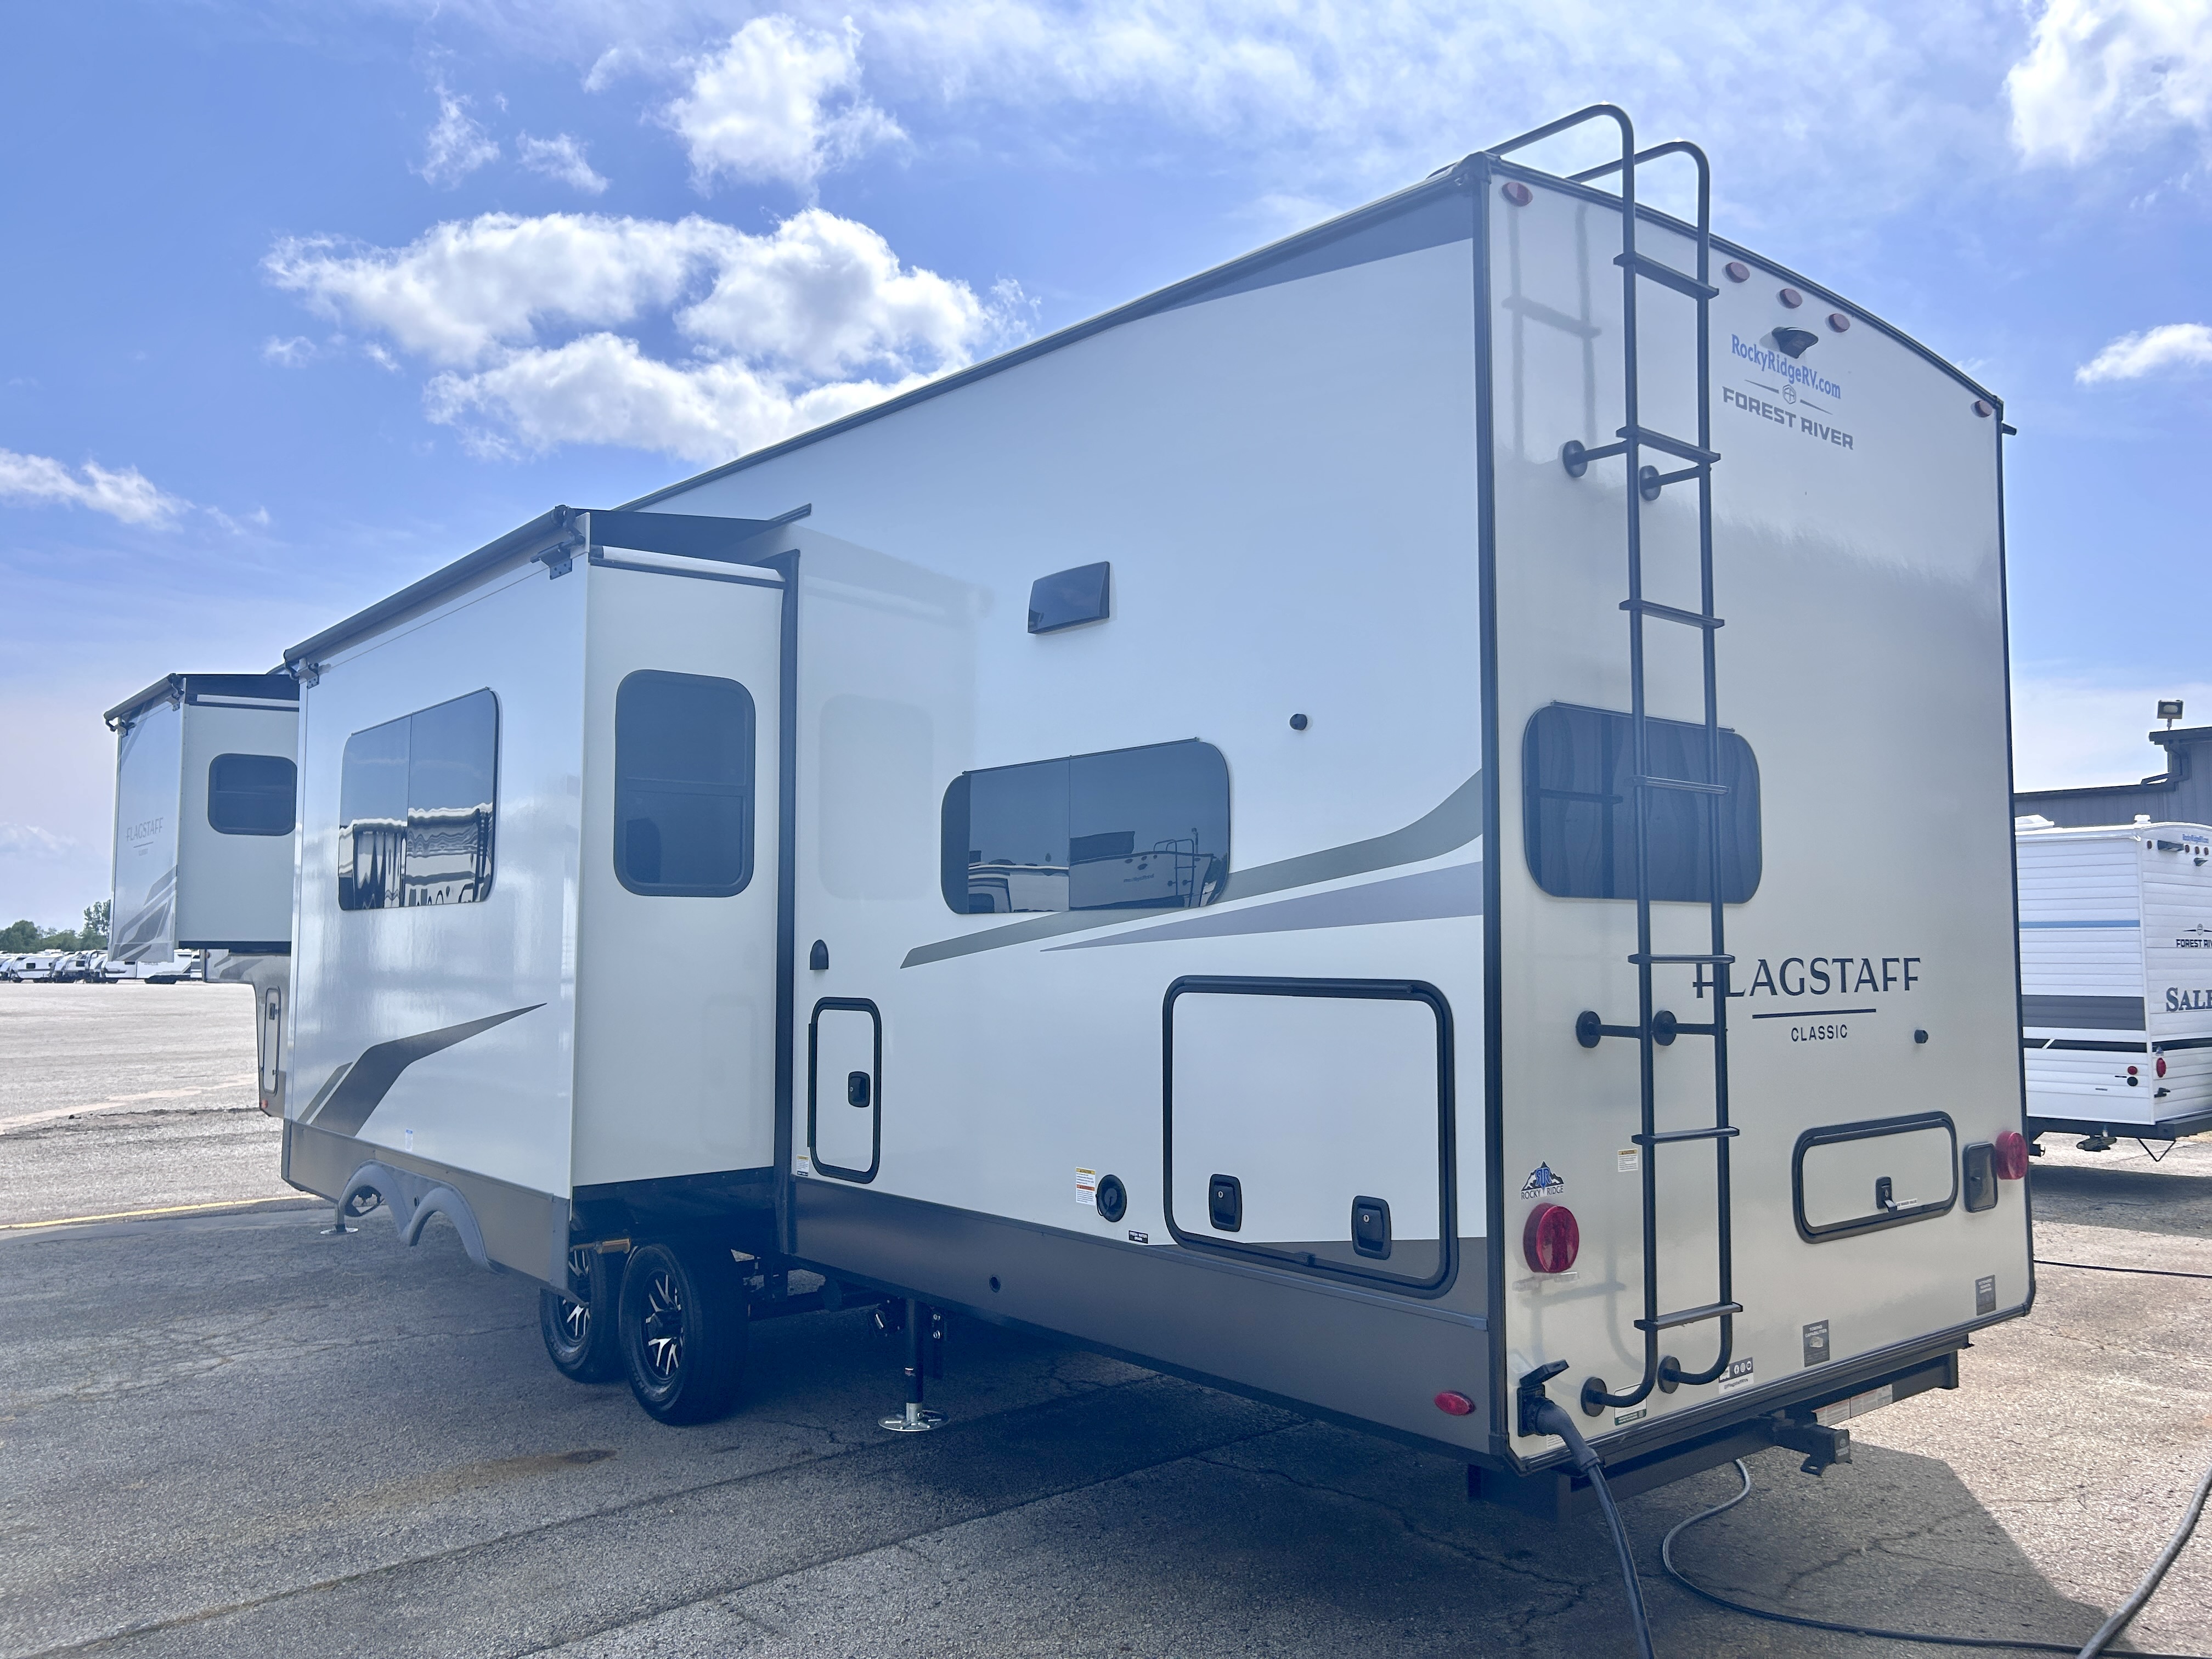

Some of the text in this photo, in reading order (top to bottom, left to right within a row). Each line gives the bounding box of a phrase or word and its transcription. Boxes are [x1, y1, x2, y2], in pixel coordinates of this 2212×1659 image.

[1731, 334, 1841, 399] RockyRidgeRV.com
[1722, 386, 1854, 450] FOREST RIVER
[126, 817, 163, 841] FLAGSTAFF
[2176, 939, 2202, 947] FOREST
[1791, 1024, 1848, 1042] CLASSIC
[1521, 1186, 1564, 1200] ROCKY RIDGE
